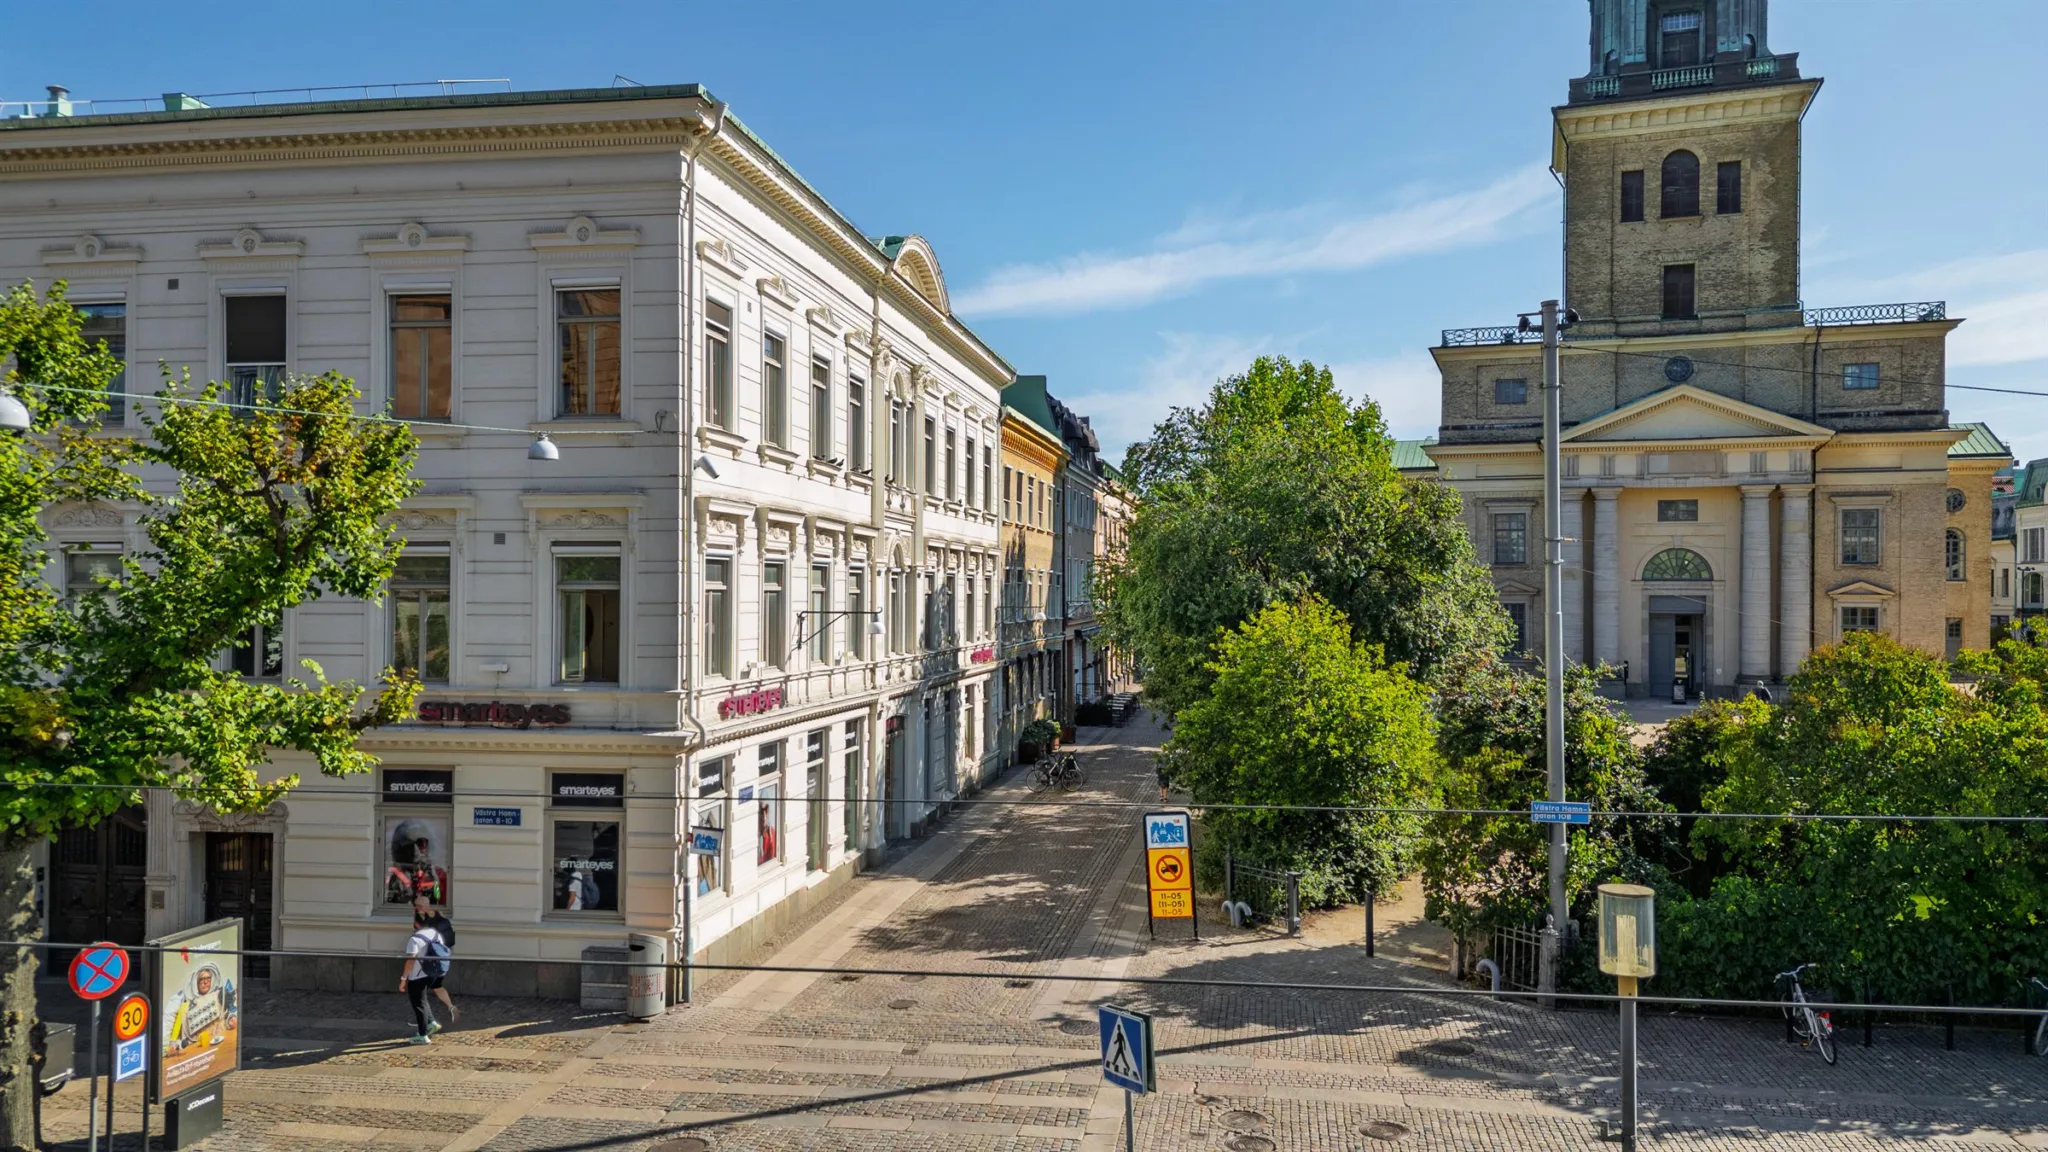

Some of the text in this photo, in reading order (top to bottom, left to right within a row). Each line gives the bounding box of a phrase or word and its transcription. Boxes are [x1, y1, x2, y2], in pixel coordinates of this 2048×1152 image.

[418, 700, 572, 729] smarteyes
[390, 782, 444, 793] smarteyes
[560, 786, 616, 797] smarteyes
[560, 860, 614, 871] smarteyes
[122, 1007, 143, 1031] 30
